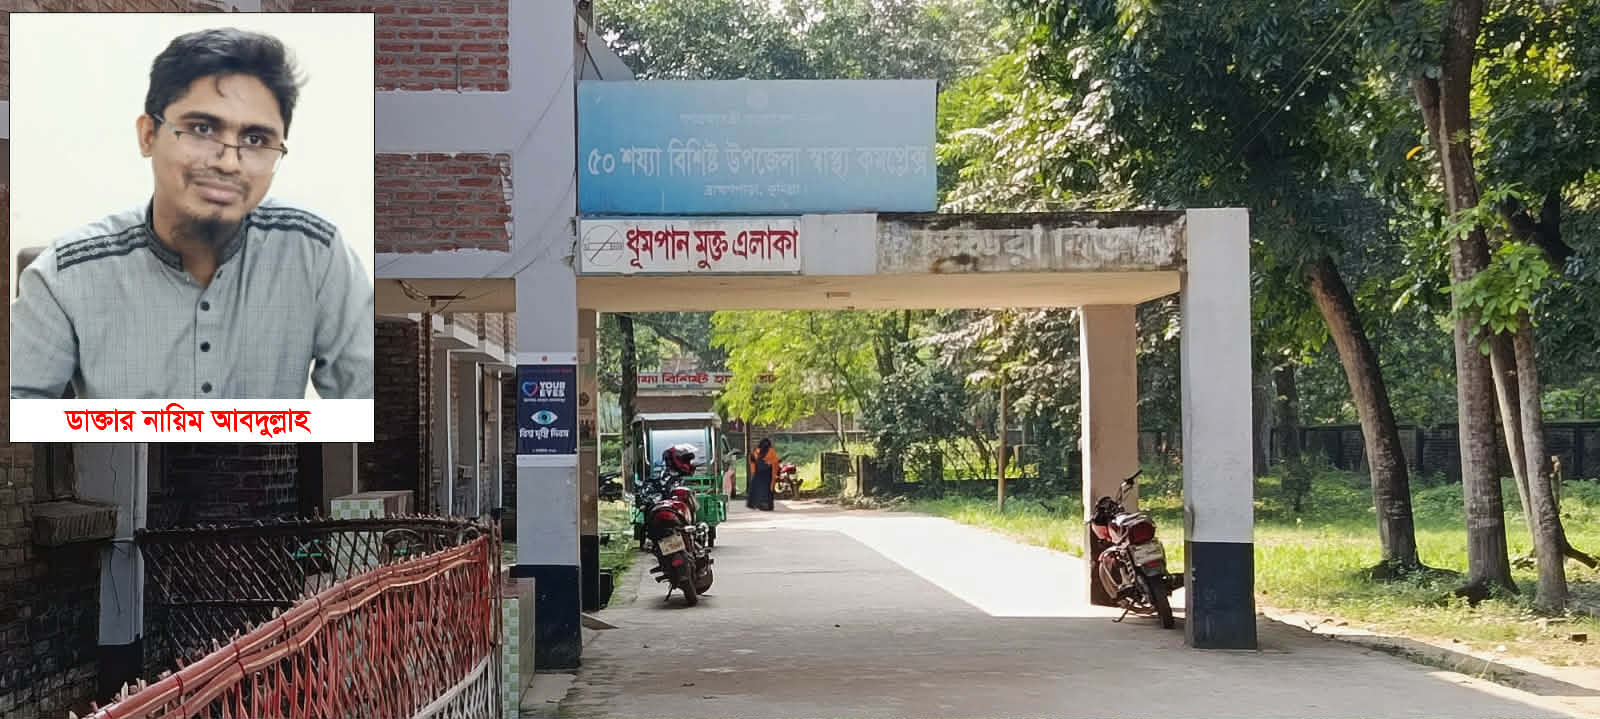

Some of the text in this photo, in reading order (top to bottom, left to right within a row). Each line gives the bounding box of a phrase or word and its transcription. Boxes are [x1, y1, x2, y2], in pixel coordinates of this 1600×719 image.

[588, 147, 615, 176] ৫০
[619, 146, 661, 176] শয্যা
[667, 138, 719, 176] বিশিষ্ট
[726, 139, 800, 176] উপজেলা
[626, 224, 799, 269] ধূমপান মুক্ত এলাকা
[539, 381, 566, 389] YOUR
